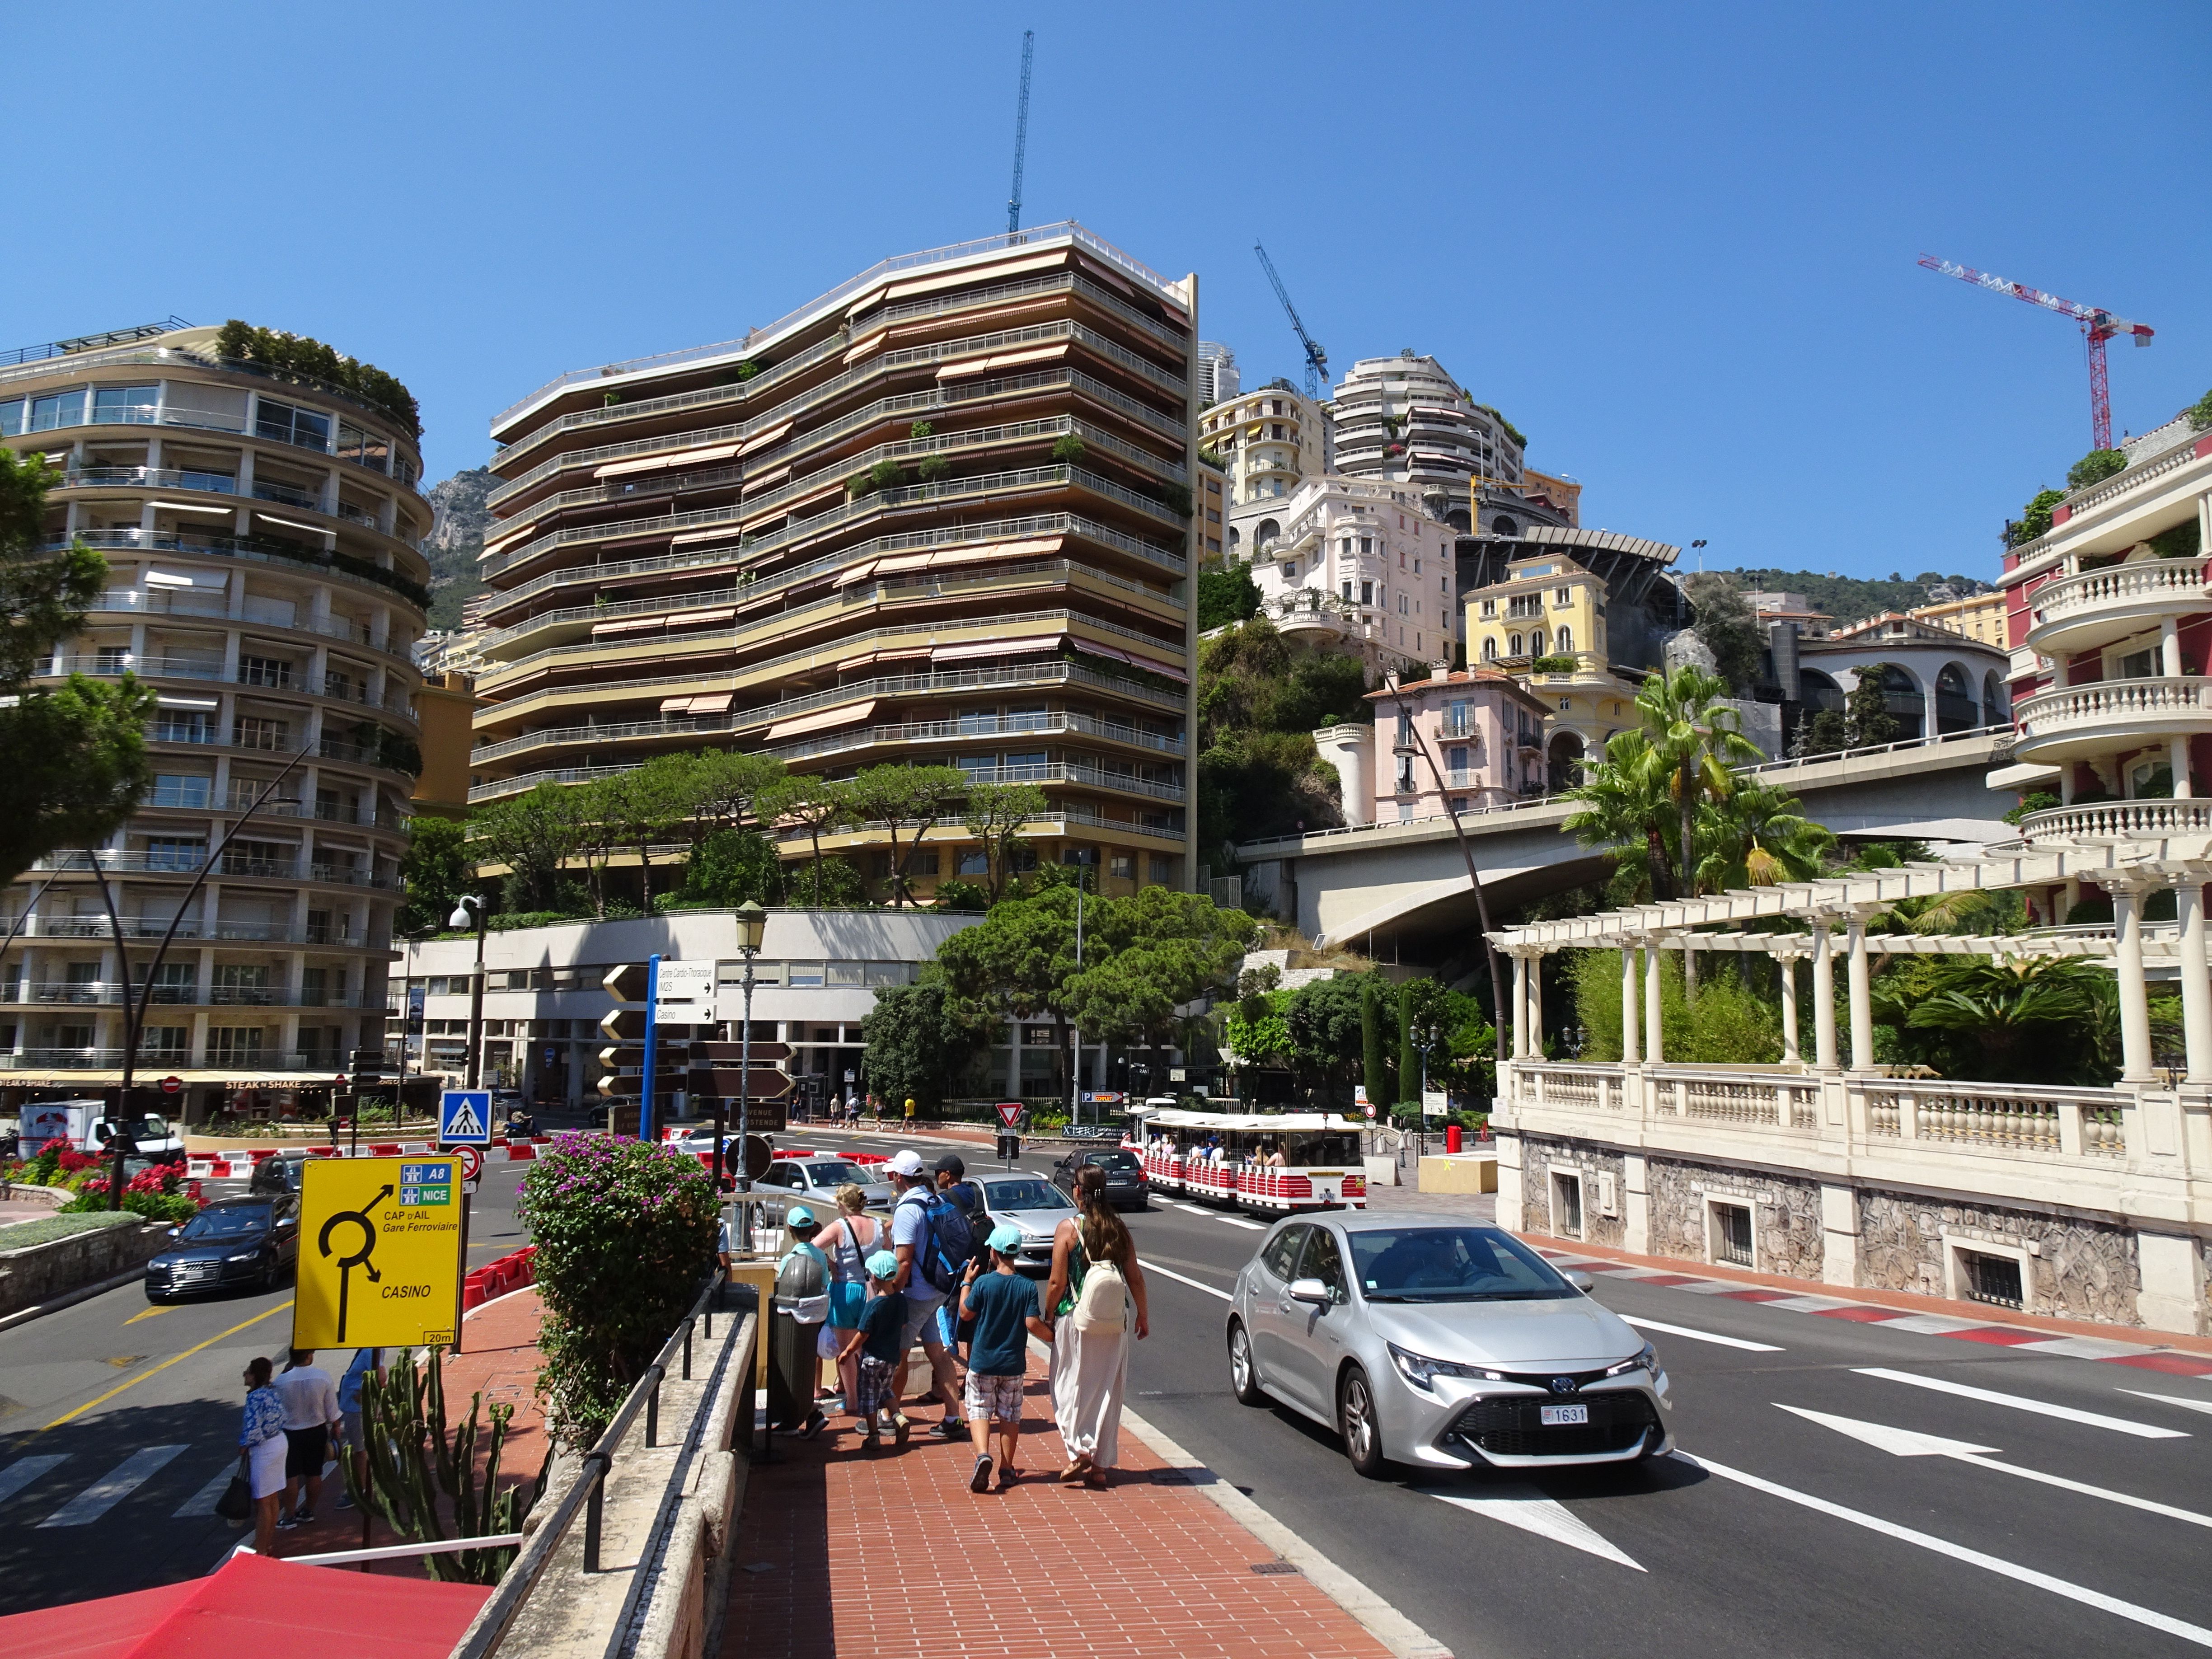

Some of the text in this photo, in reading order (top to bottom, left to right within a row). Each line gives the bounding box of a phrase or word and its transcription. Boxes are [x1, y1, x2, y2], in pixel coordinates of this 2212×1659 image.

[659, 967, 712, 979] Centre Cardio-Thoracique
[658, 981, 673, 991] IM2S
[656, 1009, 676, 1019] Casino
[225, 1081, 259, 1089] STEAK
[267, 1080, 302, 1088] SHAKE
[428, 1168, 445, 1179] A8
[422, 1190, 447, 1201] NICE
[384, 1210, 430, 1220] CAP D'AIL
[383, 1222, 458, 1233] Gare Ferroviaire
[382, 1284, 431, 1298] CASINO
[429, 1334, 451, 1343] 20m
[1555, 1408, 1584, 1422] 1631
